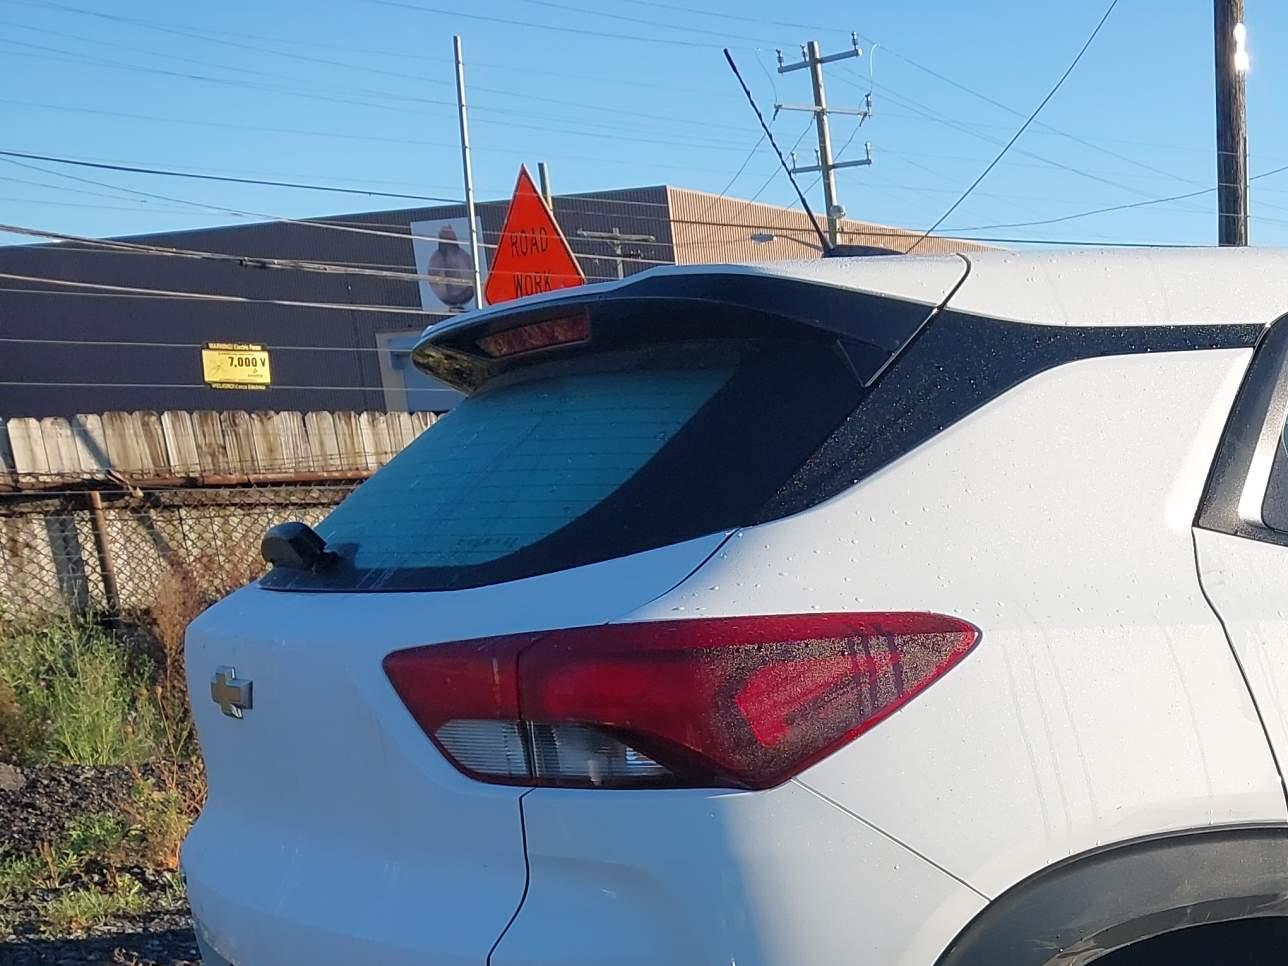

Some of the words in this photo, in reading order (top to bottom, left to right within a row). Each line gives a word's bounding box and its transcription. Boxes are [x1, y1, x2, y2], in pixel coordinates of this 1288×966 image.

[510, 227, 549, 257] ROAD
[513, 269, 552, 298] WORK
[228, 357, 257, 368] 7,000
[260, 357, 266, 367] V
